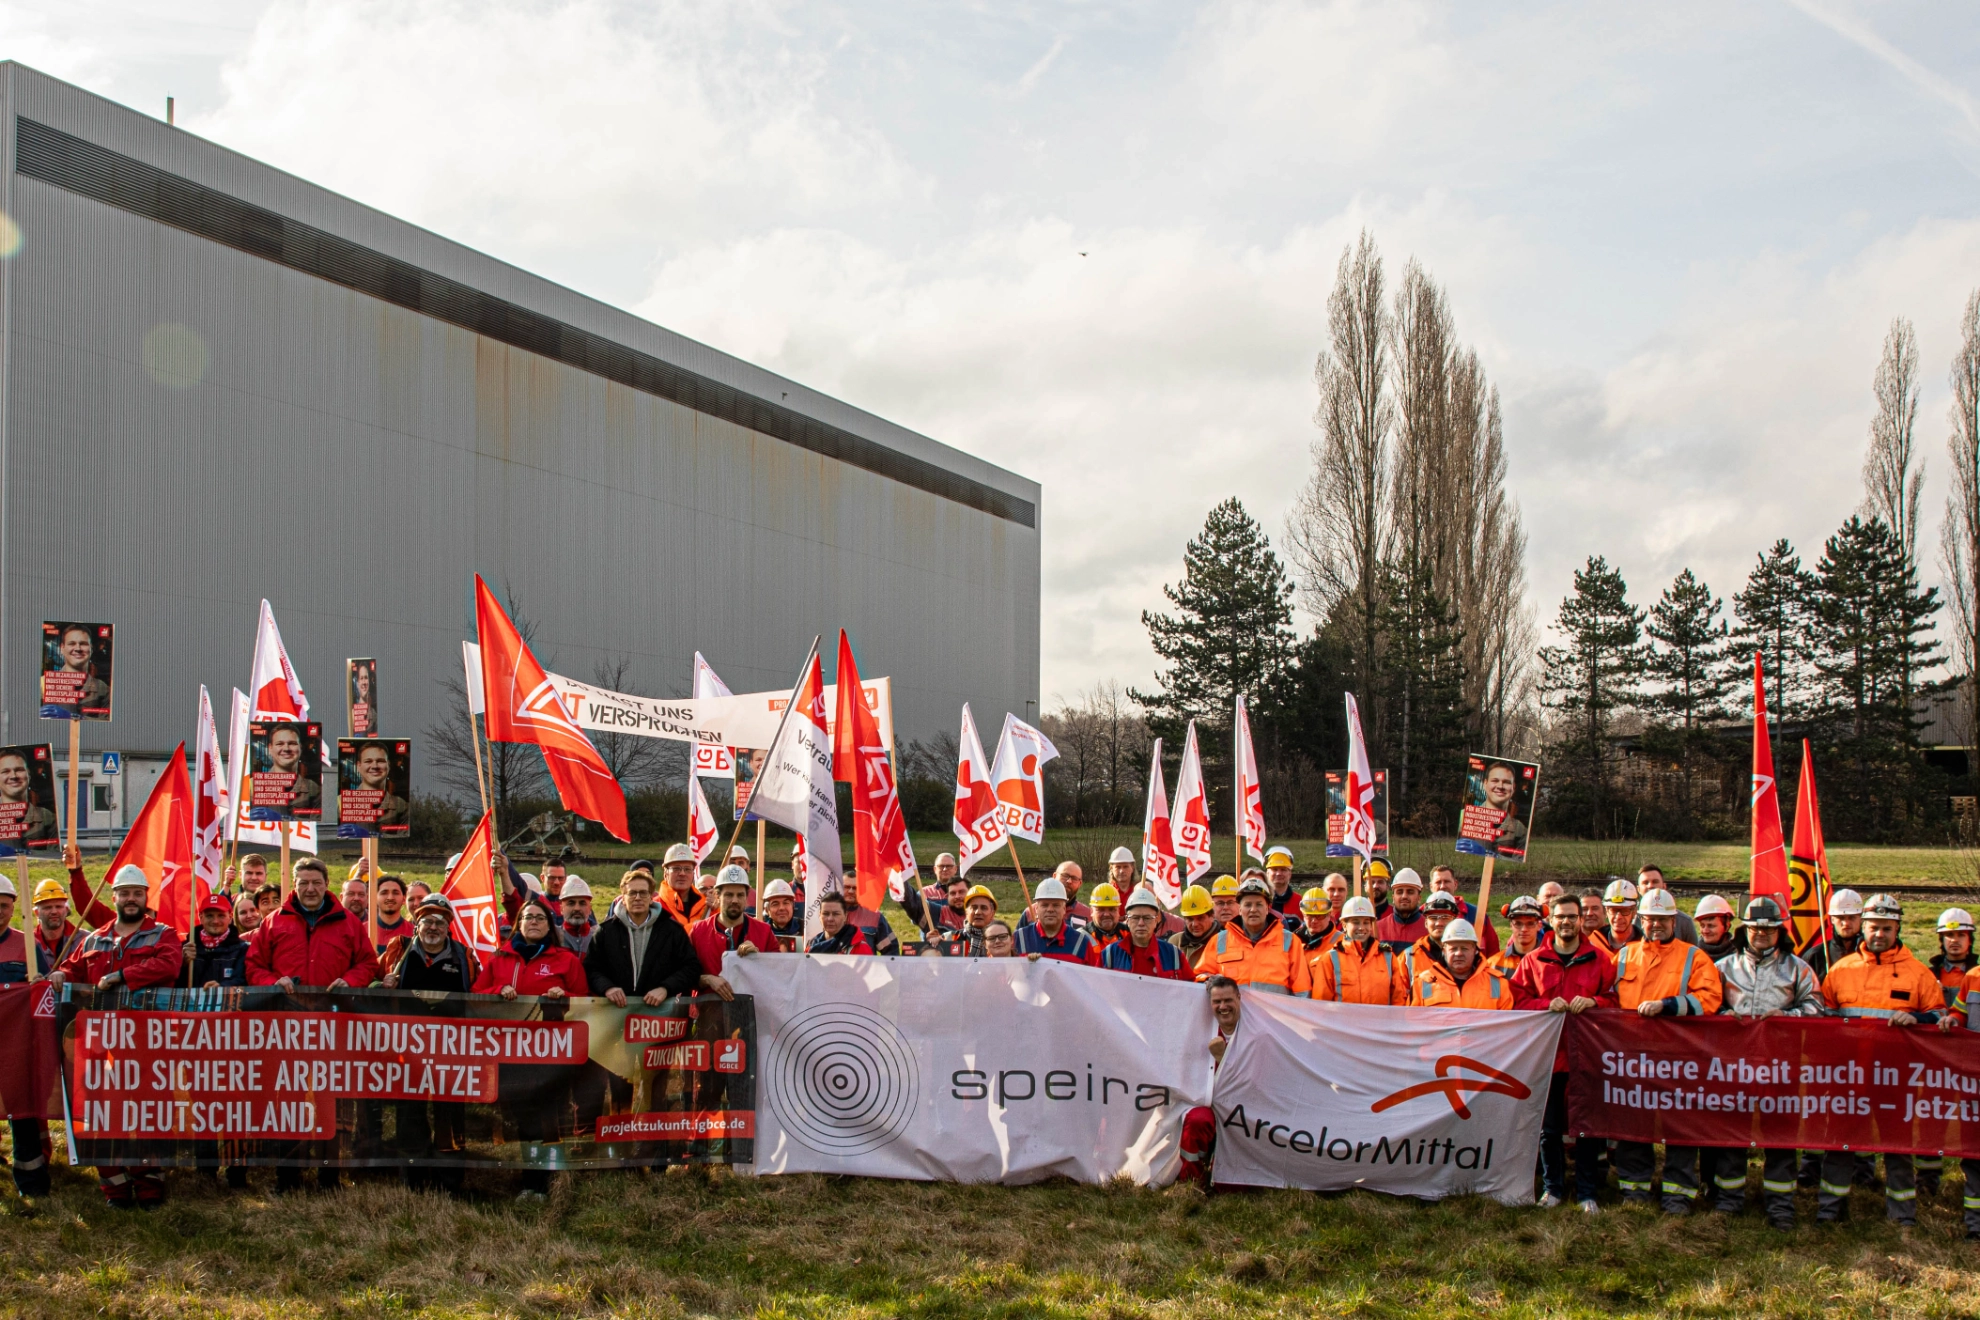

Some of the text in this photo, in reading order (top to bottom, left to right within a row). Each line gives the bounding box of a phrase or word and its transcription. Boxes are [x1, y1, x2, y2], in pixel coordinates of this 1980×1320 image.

[589, 702, 722, 743] VERSPROCHEN
[653, 705, 694, 721] UNS
[773, 699, 788, 710] PRO
[85, 1012, 573, 1058] FÜR BEZAHLBAREN INDUSTRIESTROM
[629, 1017, 687, 1039] PROJEKT
[646, 1043, 705, 1068] ZUKUNFT
[719, 1062, 739, 1070] IGBCE
[1601, 1051, 1980, 1095] Sichere Arbeit auch in Zuku
[85, 1058, 482, 1097] UND SICHERE ARBEITSPLÄTZE
[951, 1062, 1170, 1113] speira
[83, 1100, 323, 1134] IN DEUTSCHLAND.
[1603, 1079, 1871, 1119] Industriestrompreis
[1903, 1093, 1980, 1122] Jetzt!
[601, 1117, 746, 1137] projektzukunft.igbce.de
[1223, 1103, 1494, 1171] ArcelorMittal
